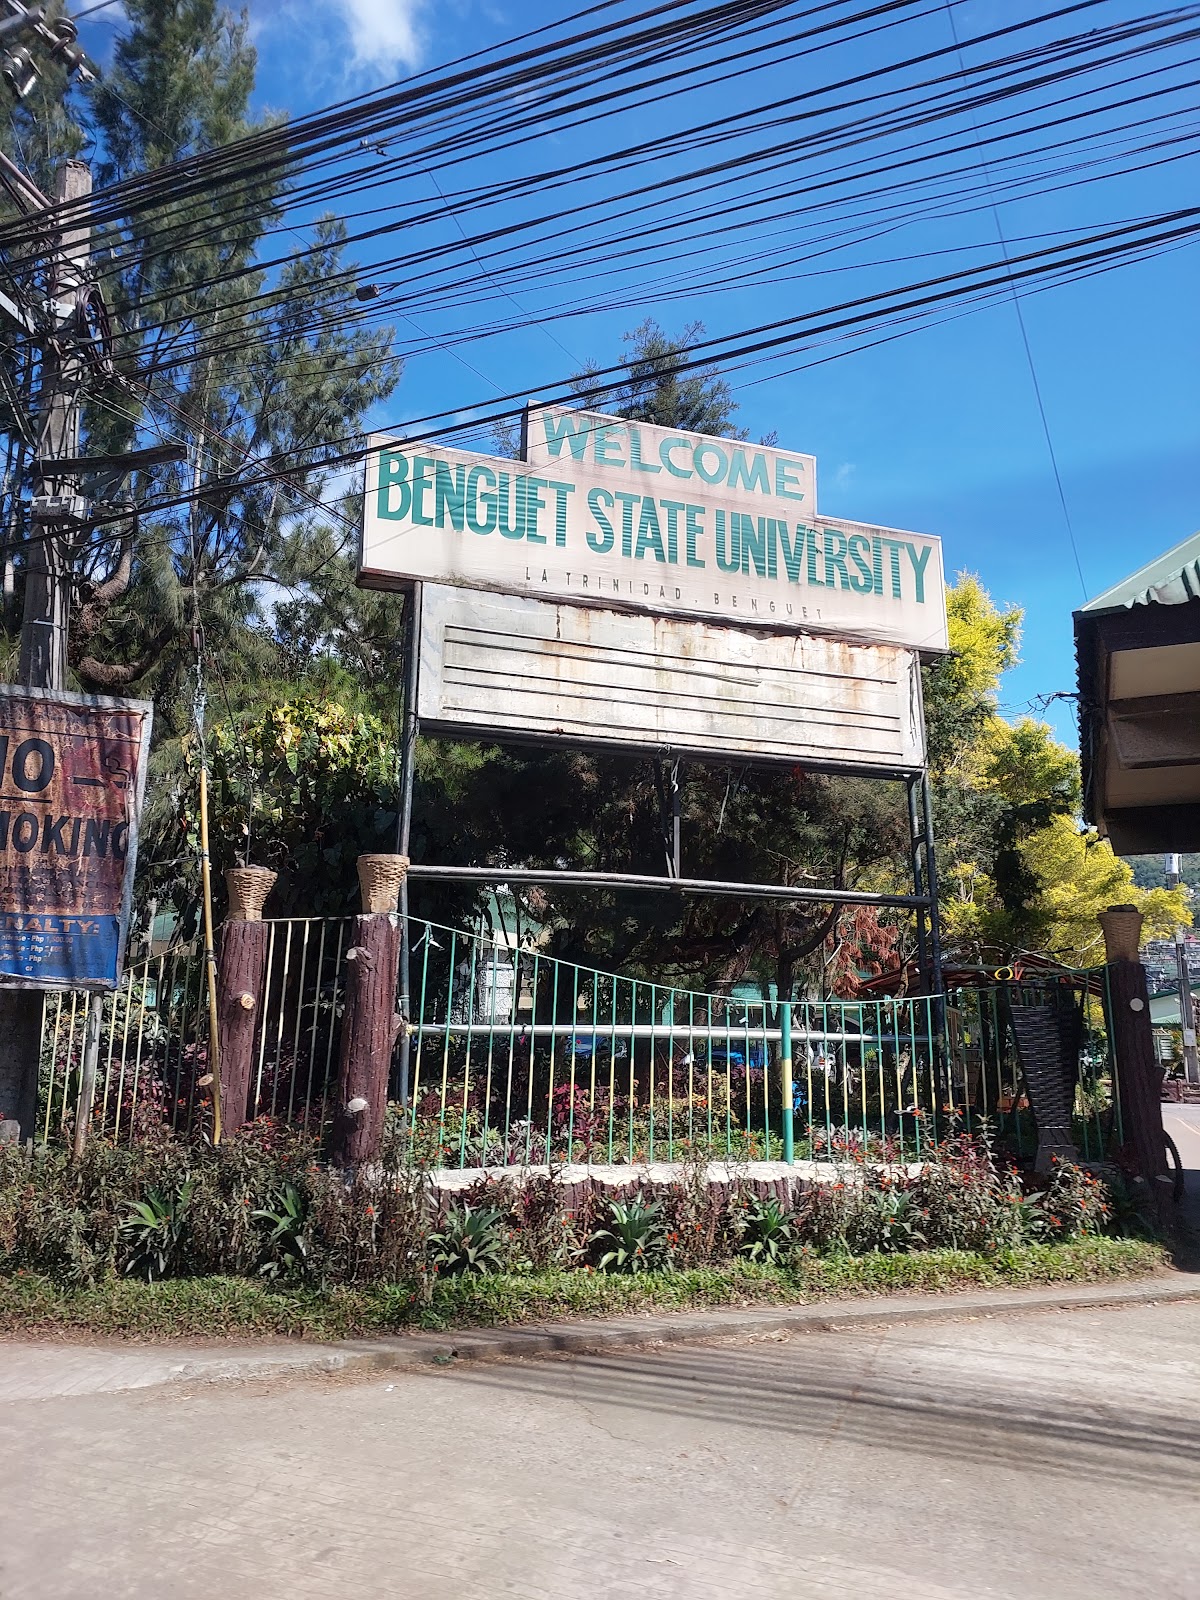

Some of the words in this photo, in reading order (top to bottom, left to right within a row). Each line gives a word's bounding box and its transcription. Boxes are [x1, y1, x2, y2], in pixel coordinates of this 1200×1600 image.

[543, 411, 805, 502] WELCOME
[377, 449, 576, 548] BENGUET
[585, 487, 706, 569] STATE
[714, 508, 933, 604] UNIVERSITY
[525, 566, 548, 583] LA
[713, 592, 823, 620] BENGUET
[0, 916, 100, 934] NALTY:
[31, 934, 45, 944] Php
[30, 944, 44, 953] Php
[28, 954, 42, 963] Php
